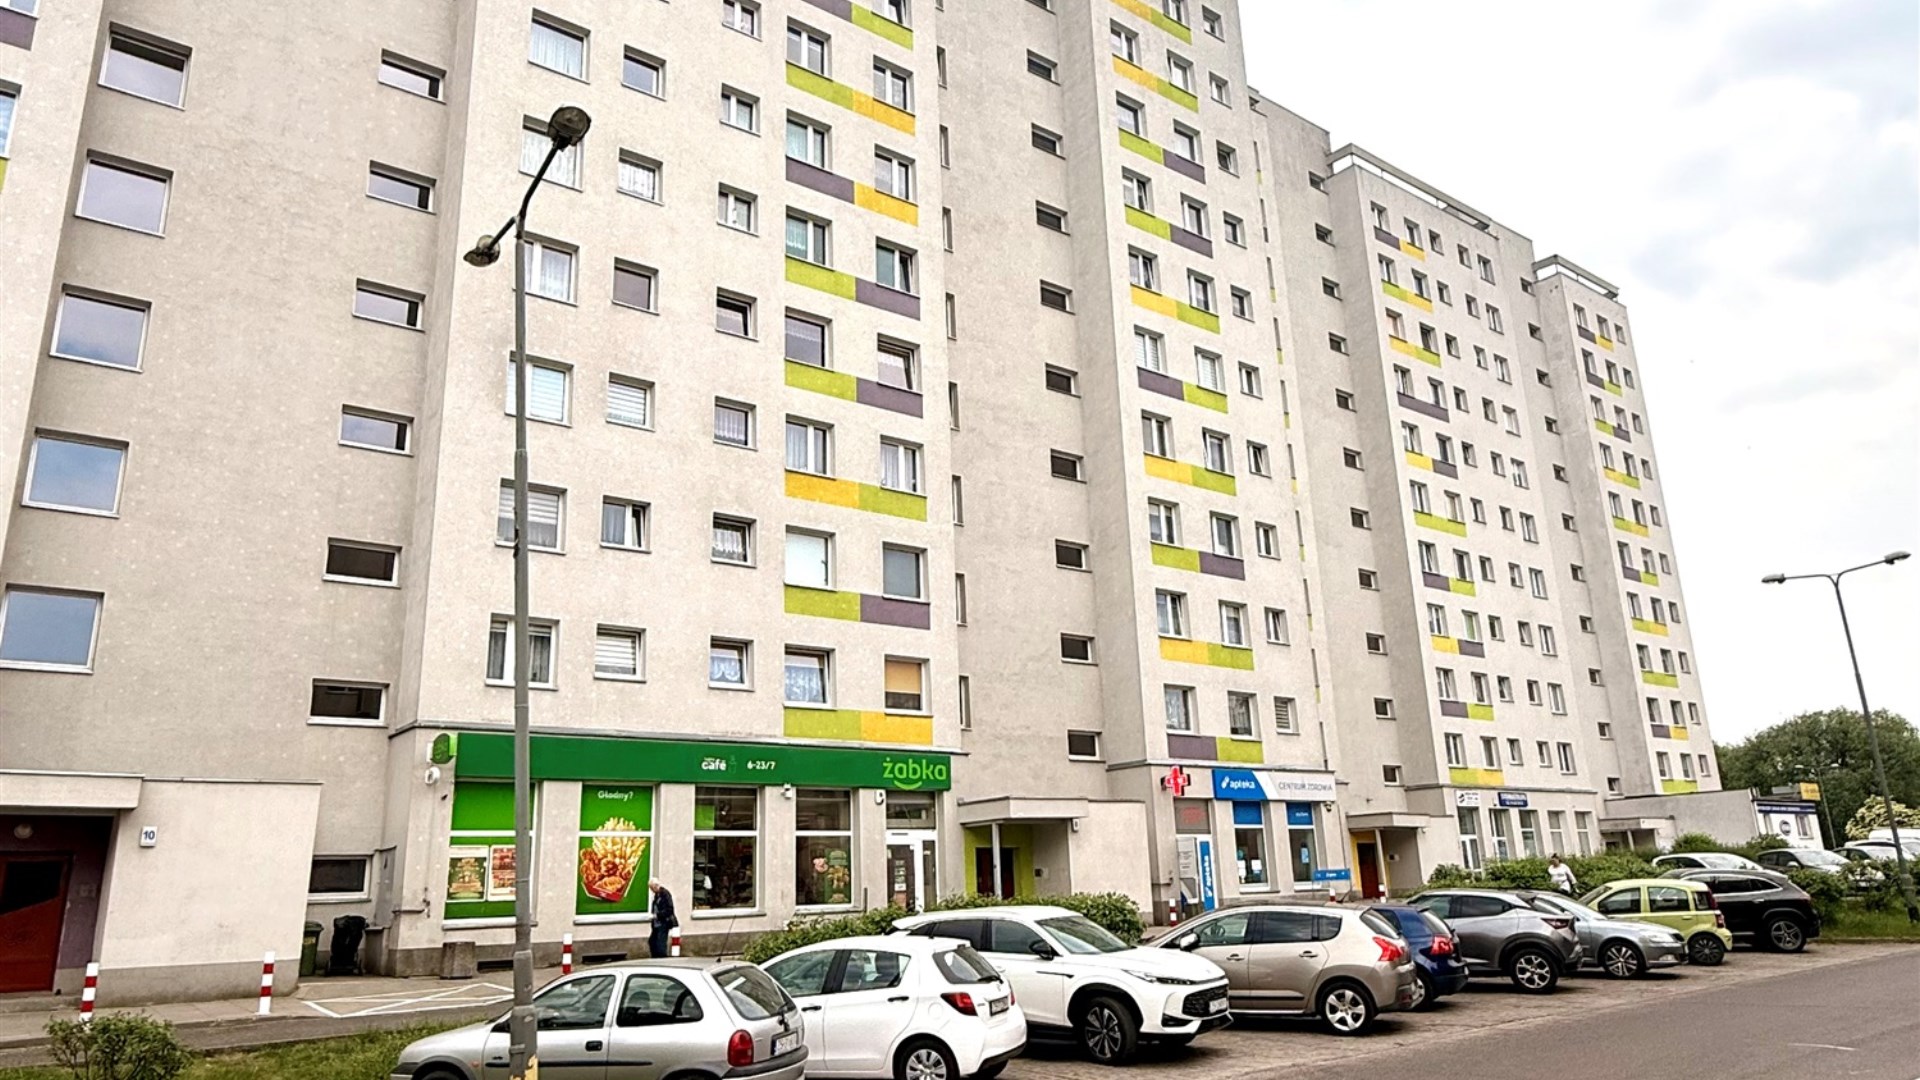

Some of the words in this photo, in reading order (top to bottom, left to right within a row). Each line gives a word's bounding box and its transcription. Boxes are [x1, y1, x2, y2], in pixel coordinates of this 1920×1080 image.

[747, 760, 776, 770] 6-23/7
[883, 757, 947, 780] żabka
[1230, 779, 1256, 790] apteka
[143, 830, 155, 840] 10
